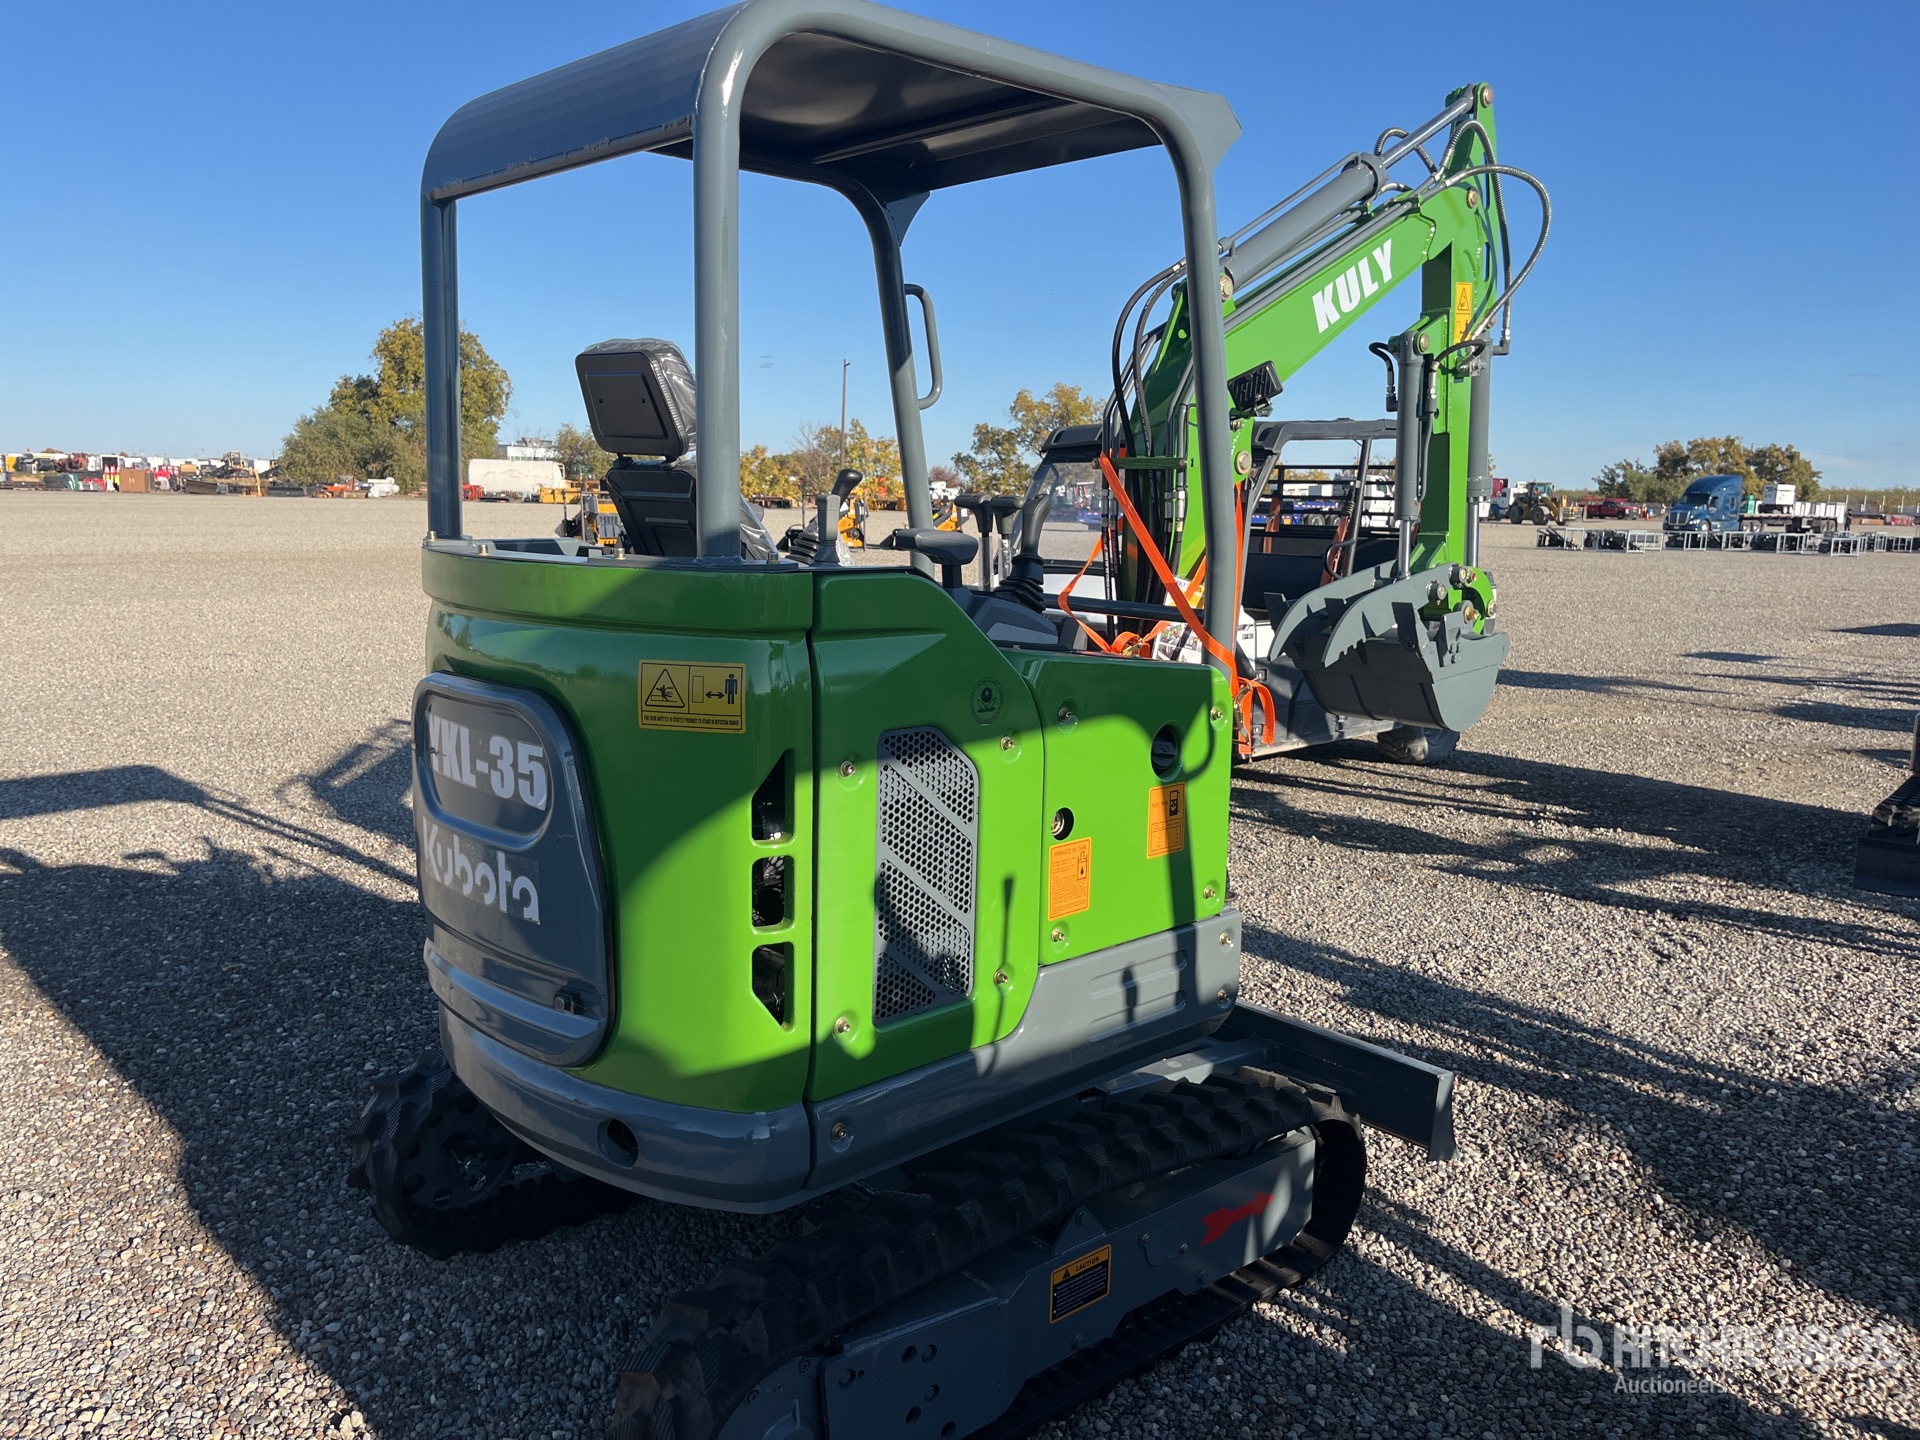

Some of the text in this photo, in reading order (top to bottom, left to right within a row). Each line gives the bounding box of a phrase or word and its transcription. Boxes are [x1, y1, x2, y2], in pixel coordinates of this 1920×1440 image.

[1312, 238, 1392, 334] KULY
[422, 816, 540, 925] Kubota
[1075, 1255, 1100, 1272] CAUTION
